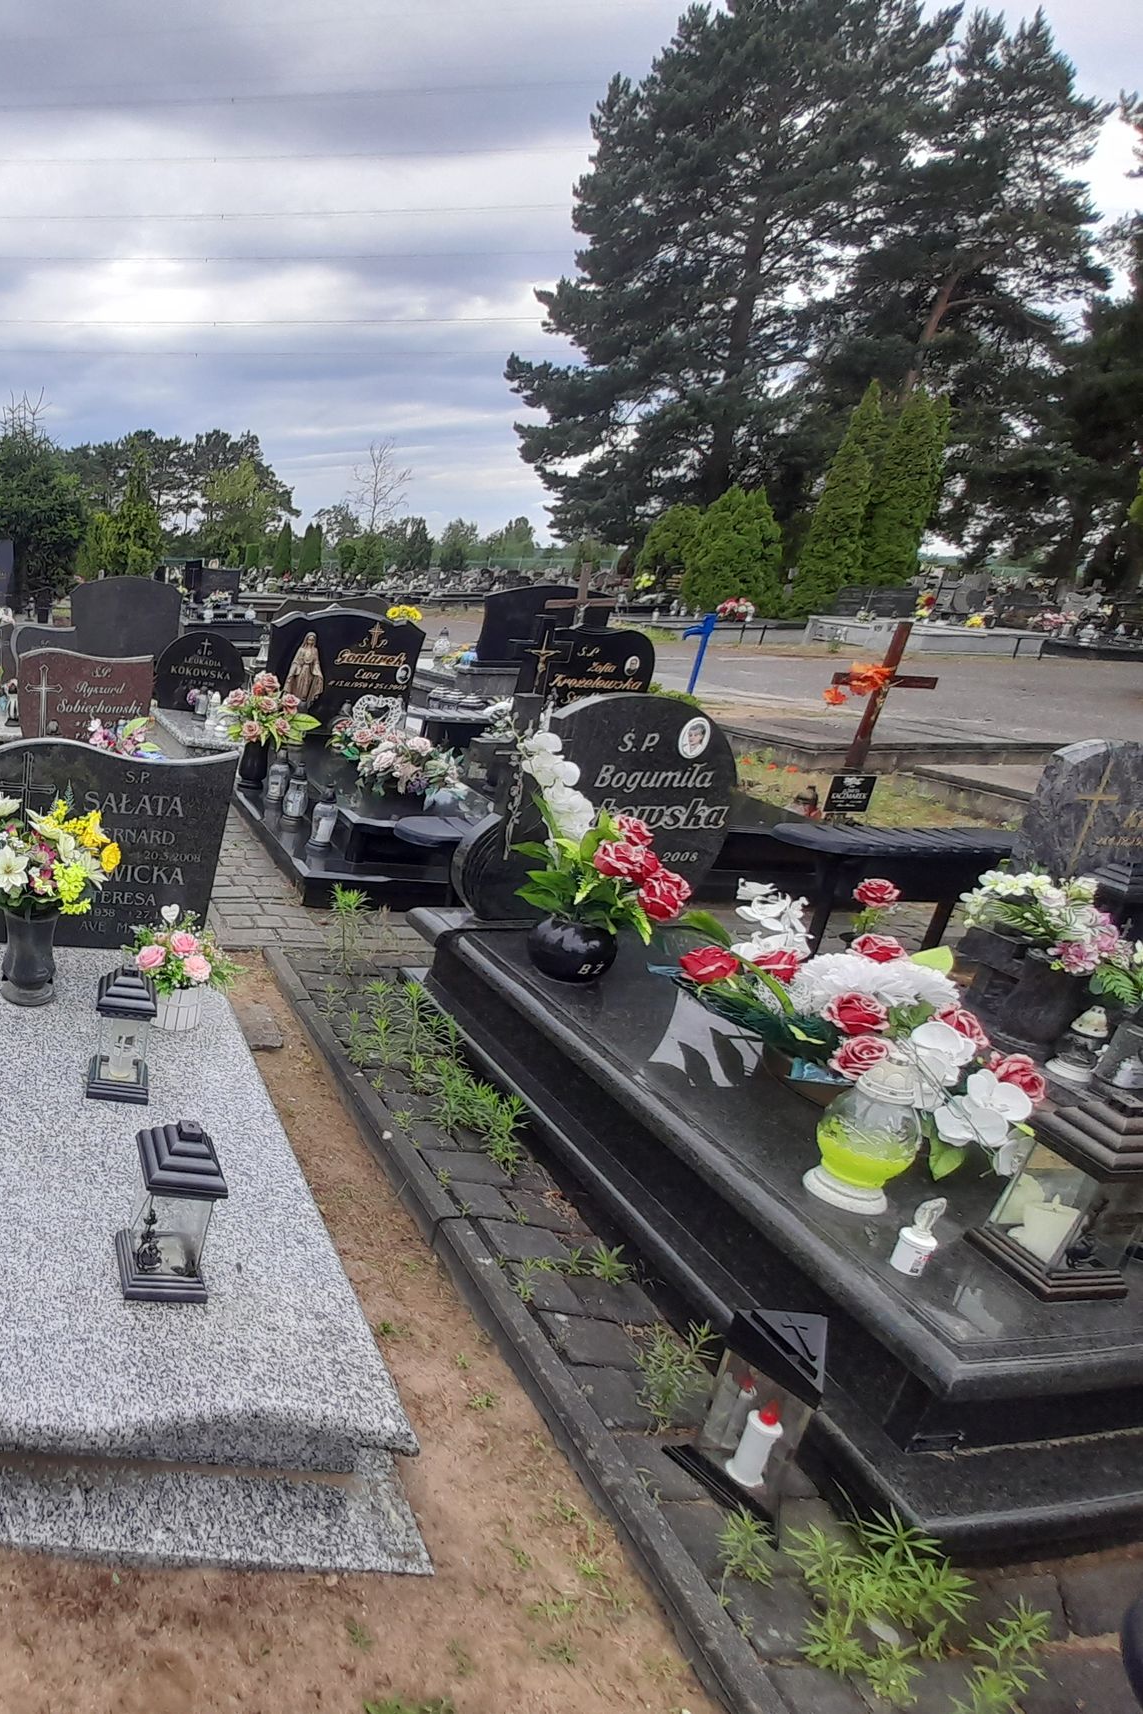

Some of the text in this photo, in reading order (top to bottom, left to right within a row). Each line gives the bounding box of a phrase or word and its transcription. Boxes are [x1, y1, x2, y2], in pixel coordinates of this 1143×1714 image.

[184, 656, 221, 667] LEUKADIA
[334, 648, 407, 667] Gontarek
[170, 665, 230, 681] KOKOWSKA
[354, 668, 380, 680] Ewa
[586, 661, 617, 674] Zofia
[74, 681, 126, 698] Ryszard
[56, 698, 143, 715] Sobiechowski
[593, 762, 715, 793] Bogumiła
[83, 790, 185, 818] SAŁATA
[104, 827, 176, 845] RNARD
[661, 851, 699, 863] 2008
[106, 864, 185, 886] WICKA
[92, 890, 157, 906] TERESA
[80, 919, 107, 933] AVE
